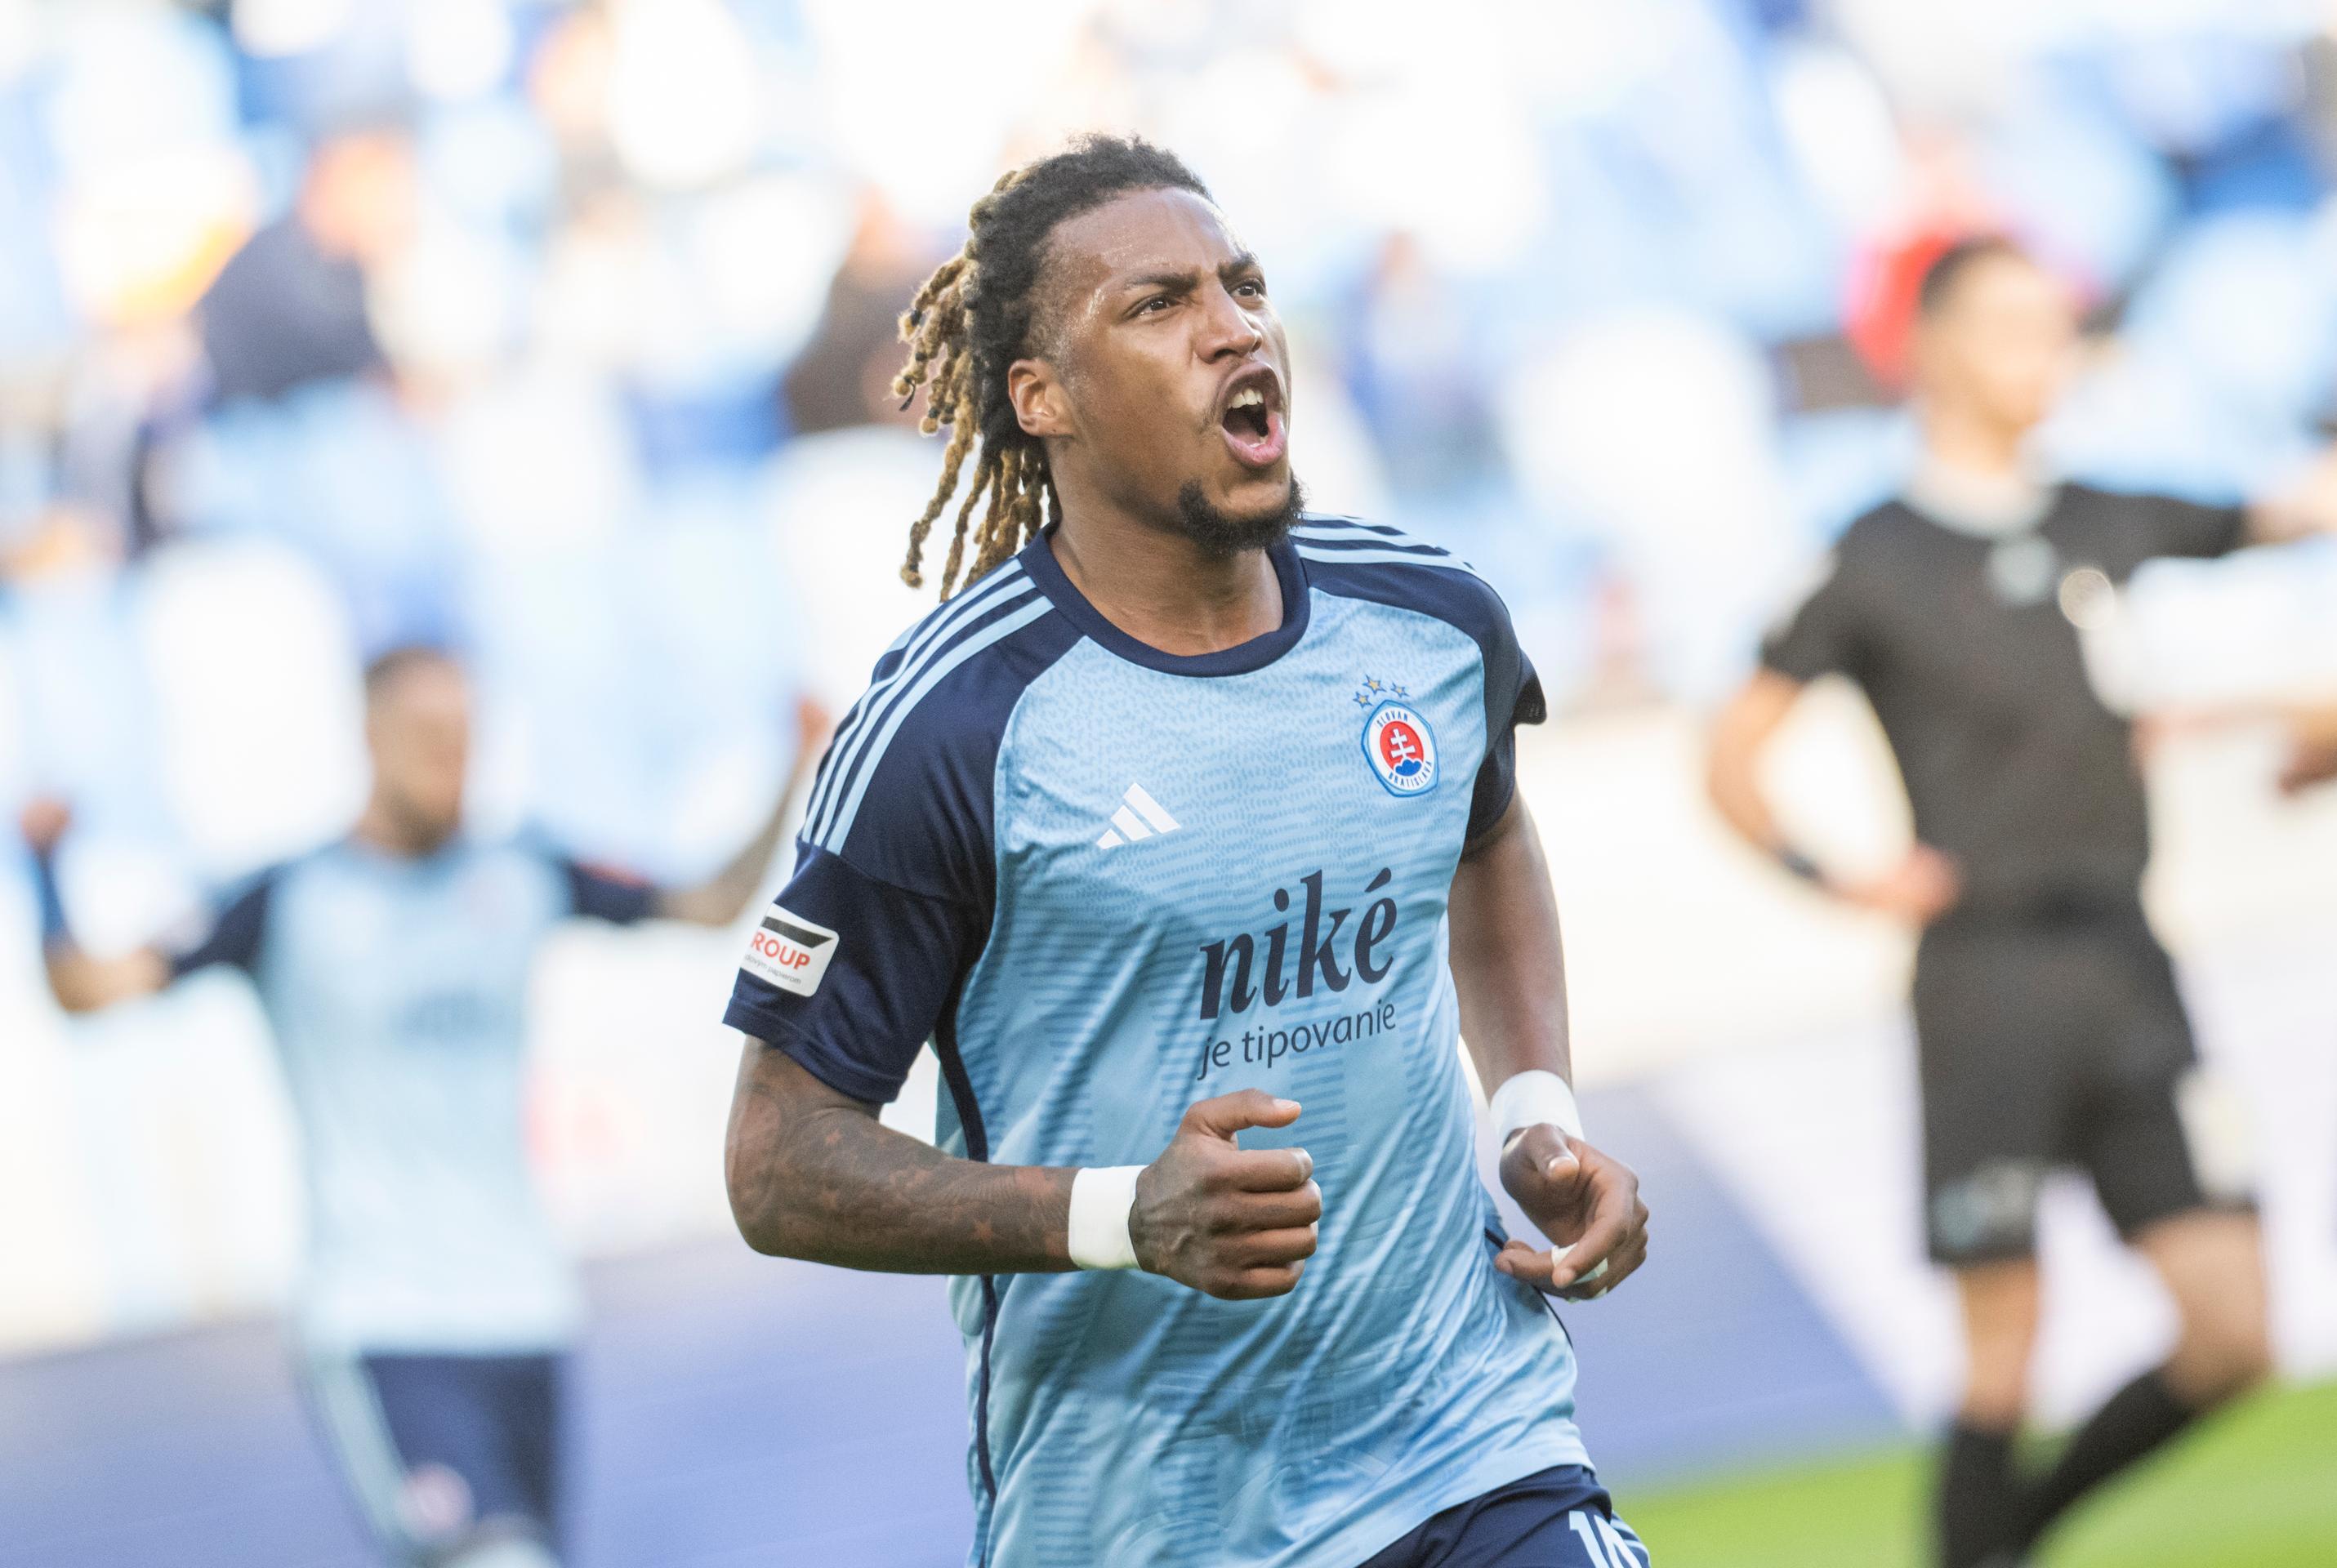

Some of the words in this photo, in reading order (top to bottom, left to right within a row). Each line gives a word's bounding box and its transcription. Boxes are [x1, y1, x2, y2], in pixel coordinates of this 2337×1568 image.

[1376, 710, 1409, 728] SLOVAN
[1389, 760, 1432, 788] BRATISLAVA
[1199, 867, 1398, 1020] niké
[1197, 1036, 1232, 1081] je
[1242, 999, 1396, 1069] tipovanie
